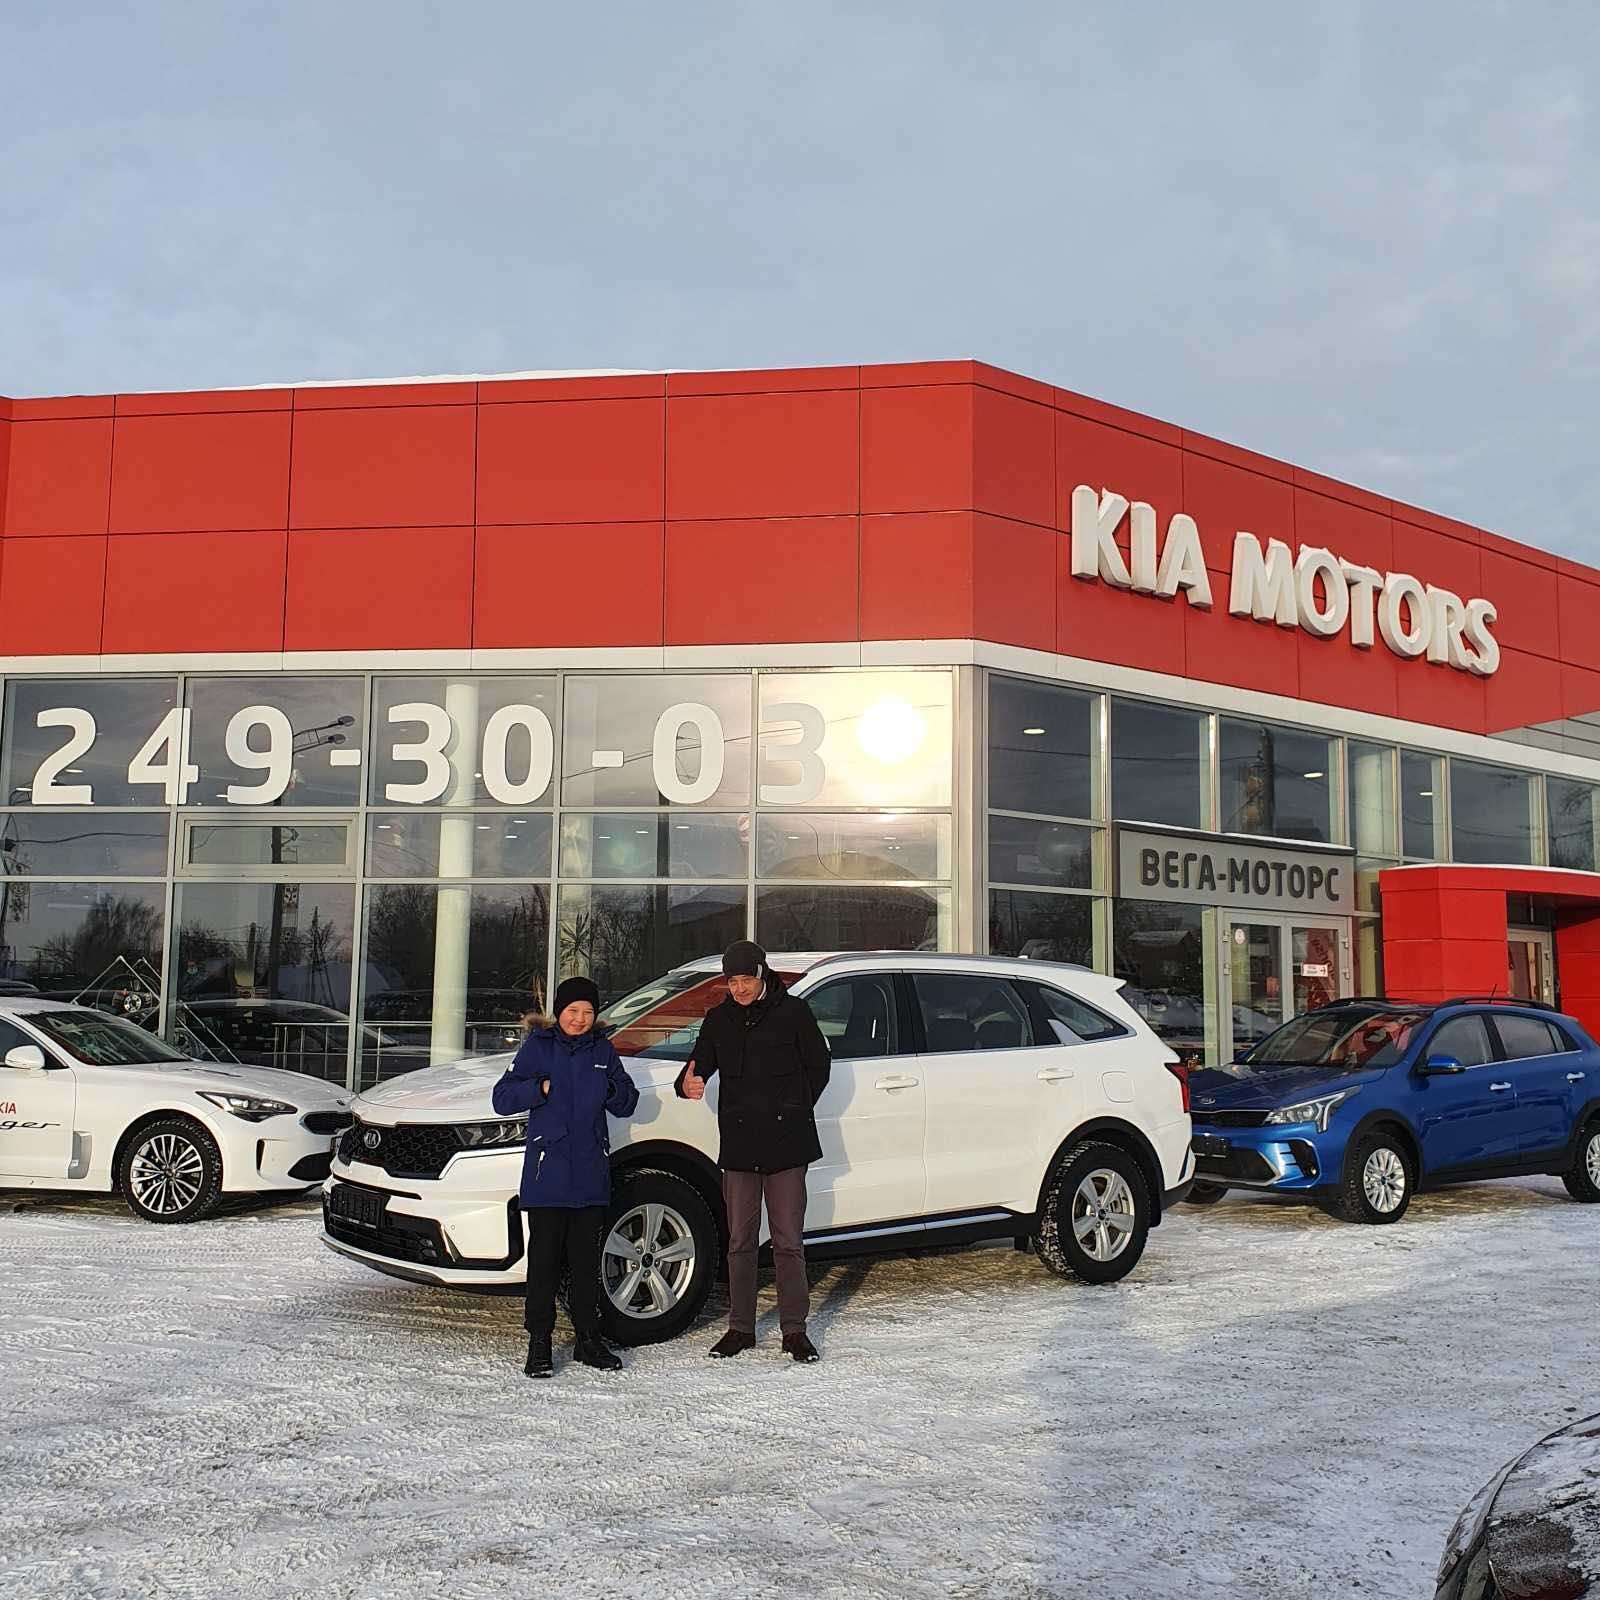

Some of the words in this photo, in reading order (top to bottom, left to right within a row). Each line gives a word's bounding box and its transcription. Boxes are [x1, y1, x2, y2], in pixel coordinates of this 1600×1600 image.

[1071, 485, 1213, 611] KIA
[1229, 531, 1501, 676] MOTORS
[1140, 848, 1340, 902] ВЕГА-МОТОРС
[0, 1102, 16, 1114] KIA
